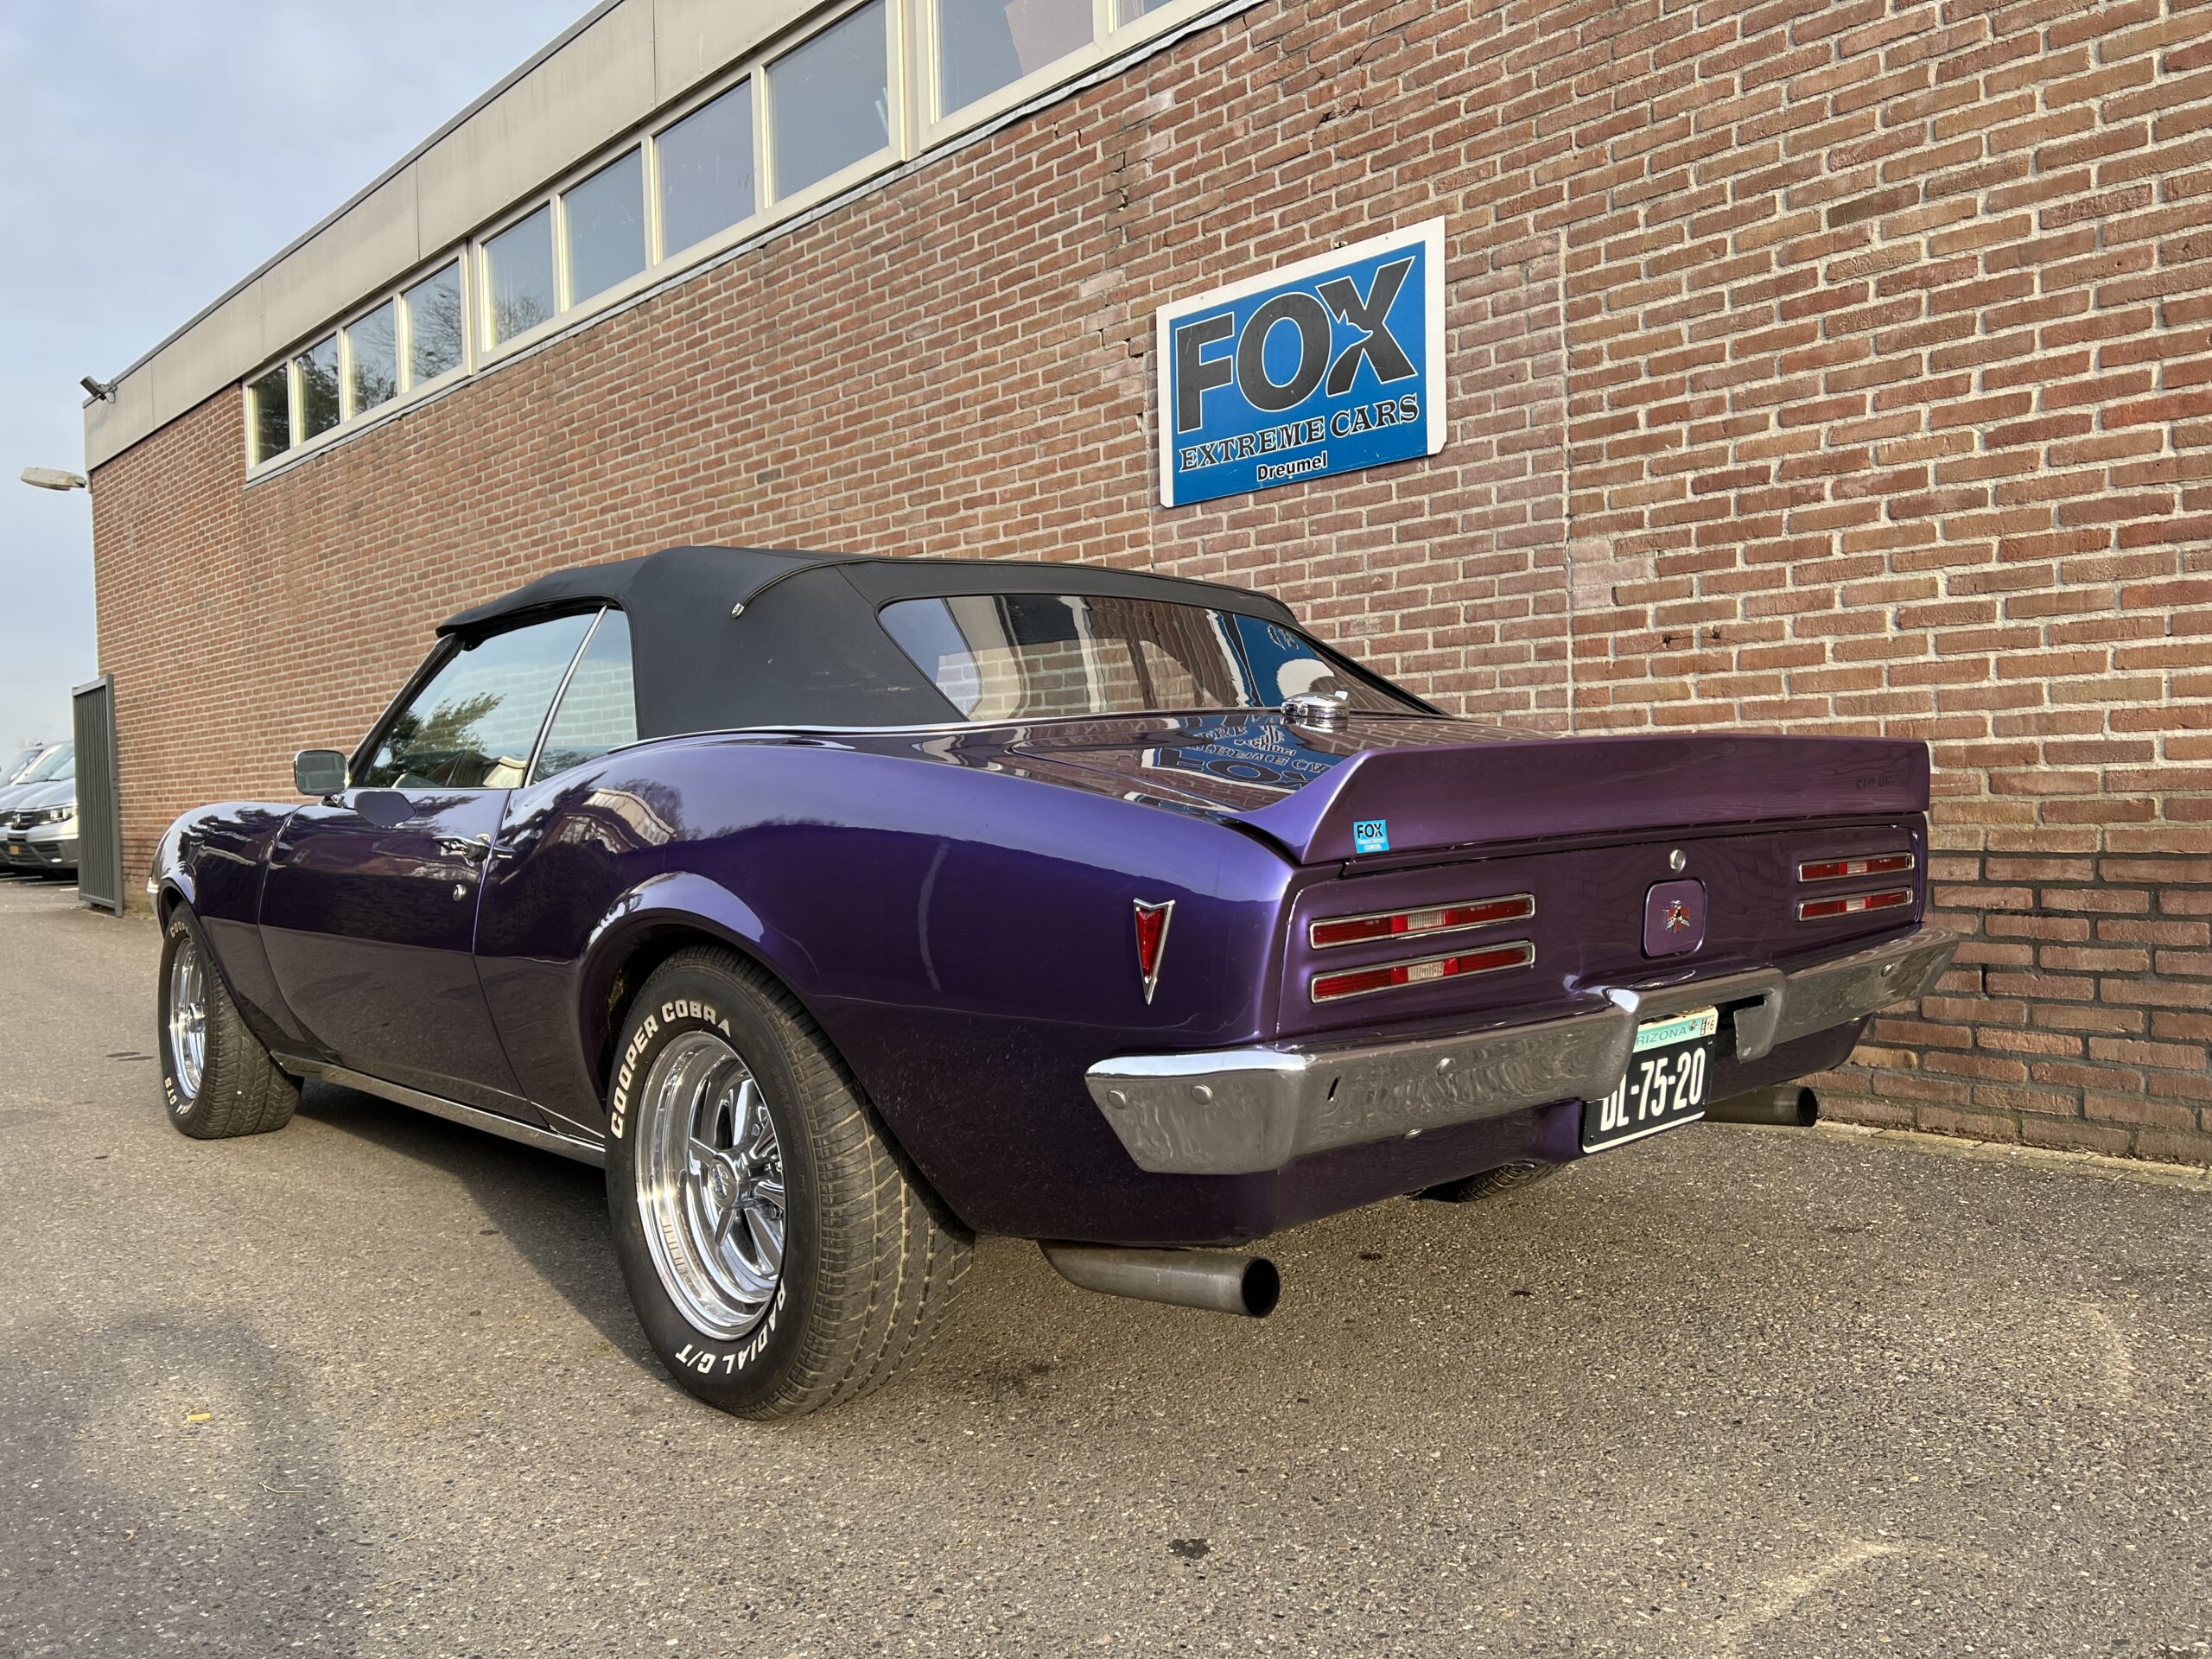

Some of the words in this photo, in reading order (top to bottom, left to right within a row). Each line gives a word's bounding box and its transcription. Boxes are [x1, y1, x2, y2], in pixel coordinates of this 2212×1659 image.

[1175, 256, 1419, 434] FOX
[1179, 416, 1325, 473] EXTREME
[1331, 393, 1419, 437] CARS
[1256, 451, 1328, 482] Dreumel
[1357, 823, 1383, 838] FOX
[1637, 1027, 1687, 1045] RIZONA
[610, 1014, 659, 1139] COOPER
[661, 1000, 731, 1037] COBRA
[722, 1278, 786, 1375] RADIAL
[675, 1344, 716, 1374] G/T
